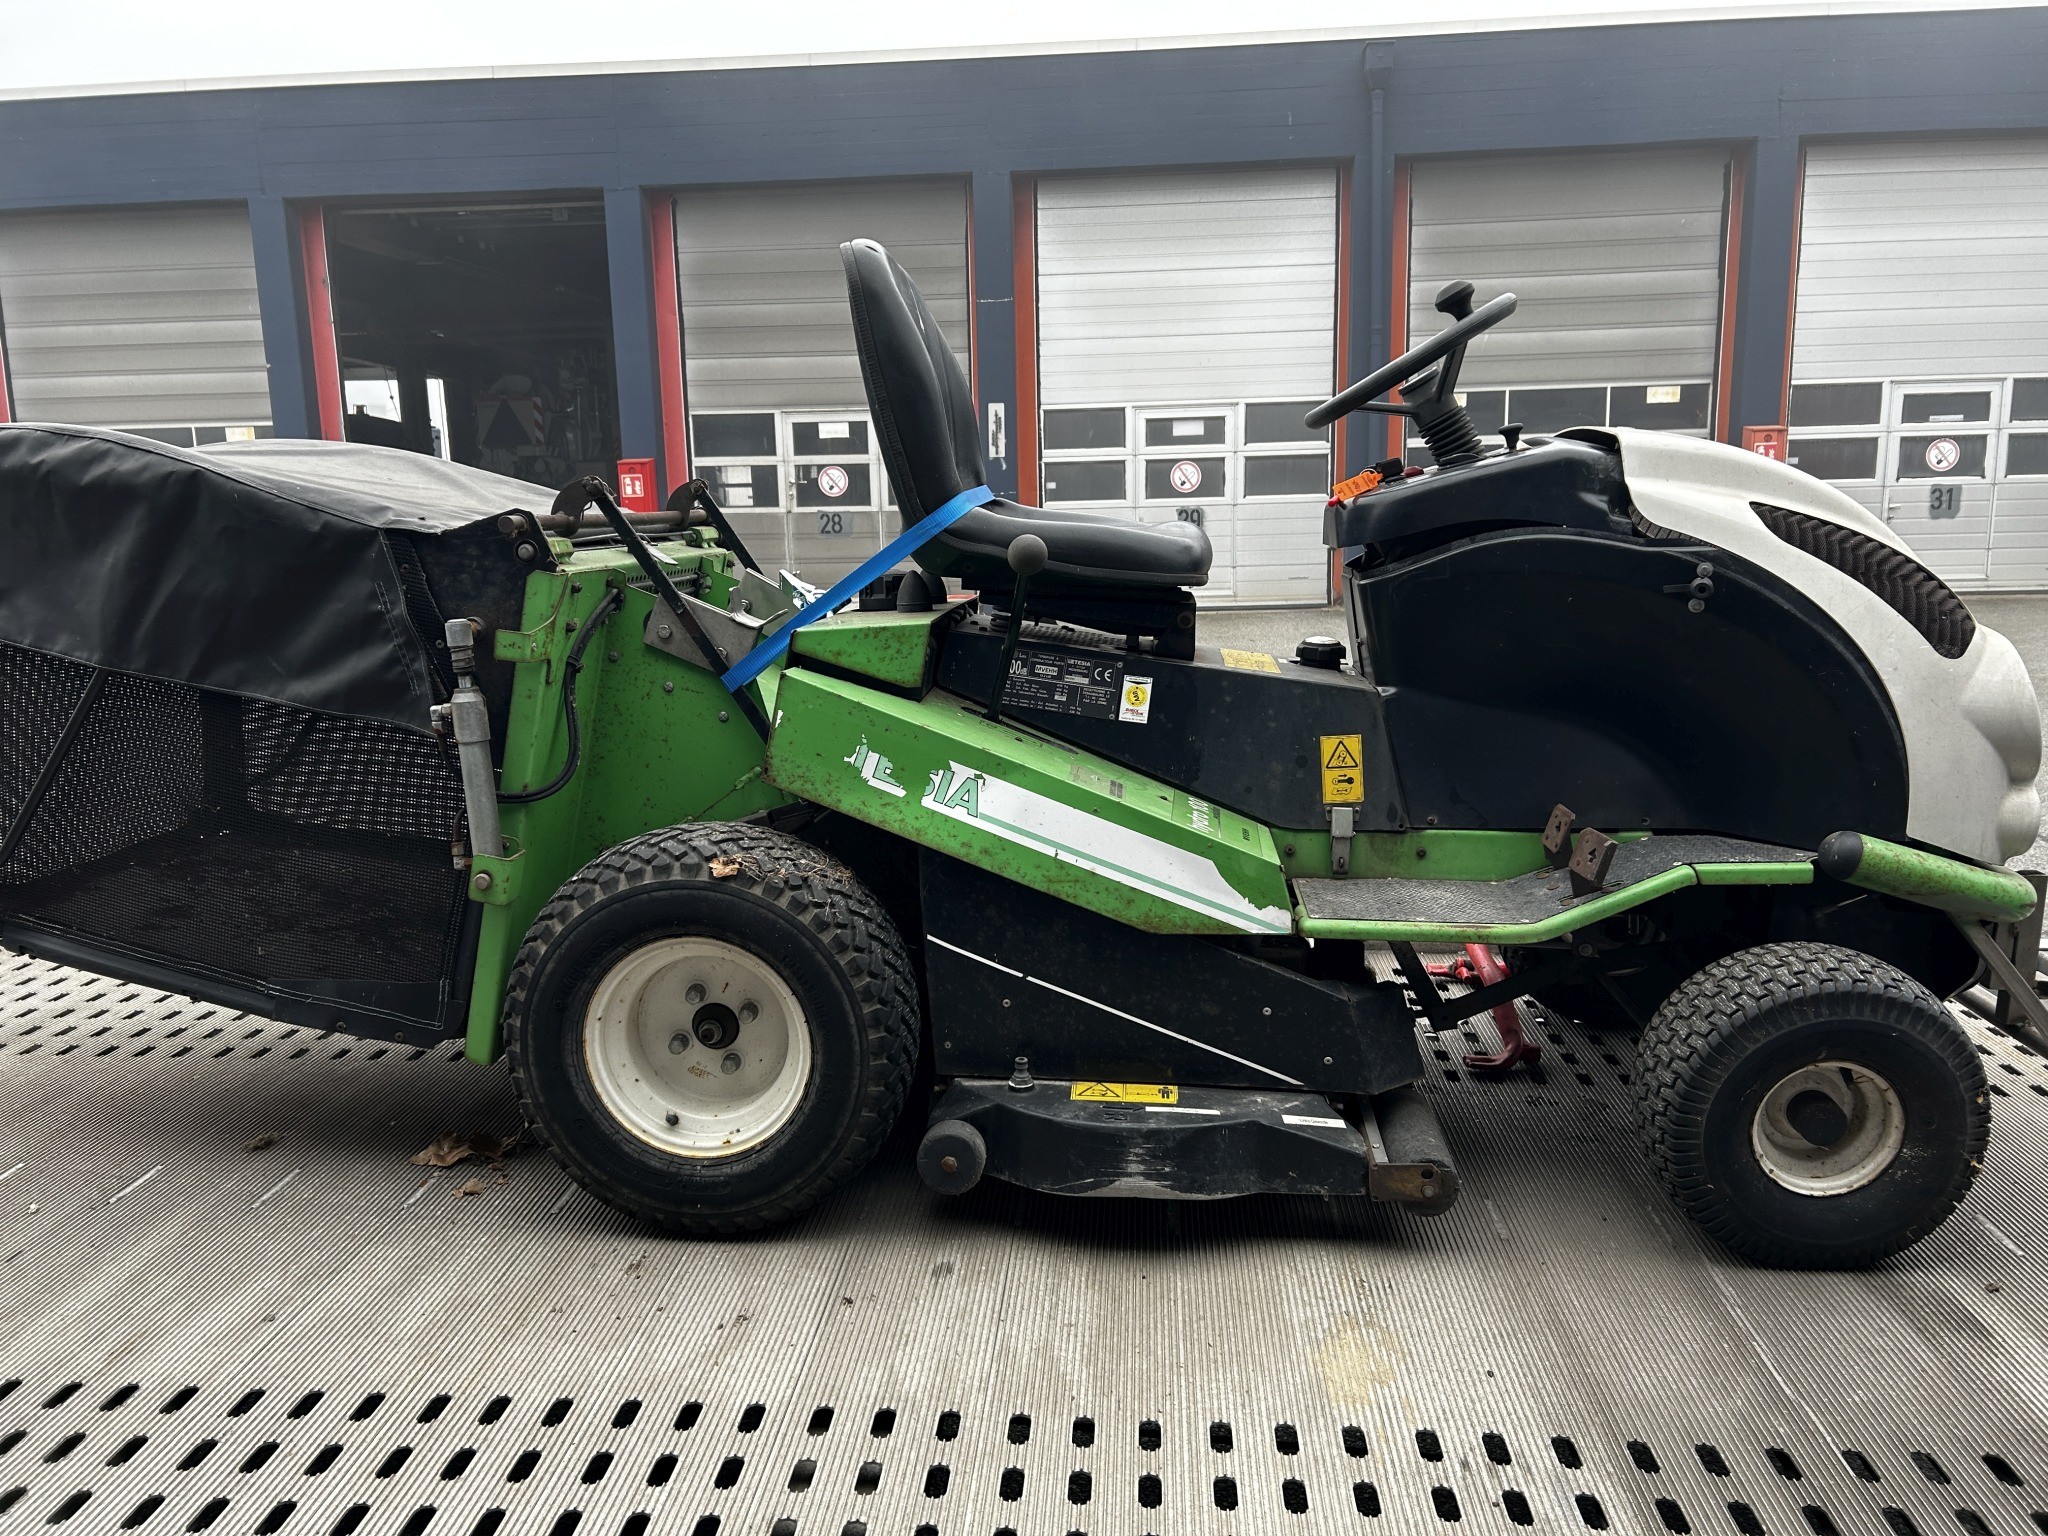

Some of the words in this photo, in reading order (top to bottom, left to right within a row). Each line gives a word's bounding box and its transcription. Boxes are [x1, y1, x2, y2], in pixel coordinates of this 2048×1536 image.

[1930, 487, 1954, 510] 31
[820, 513, 843, 534] 28
[1178, 508, 1200, 527] 29
[1094, 667, 1113, 682] CE
